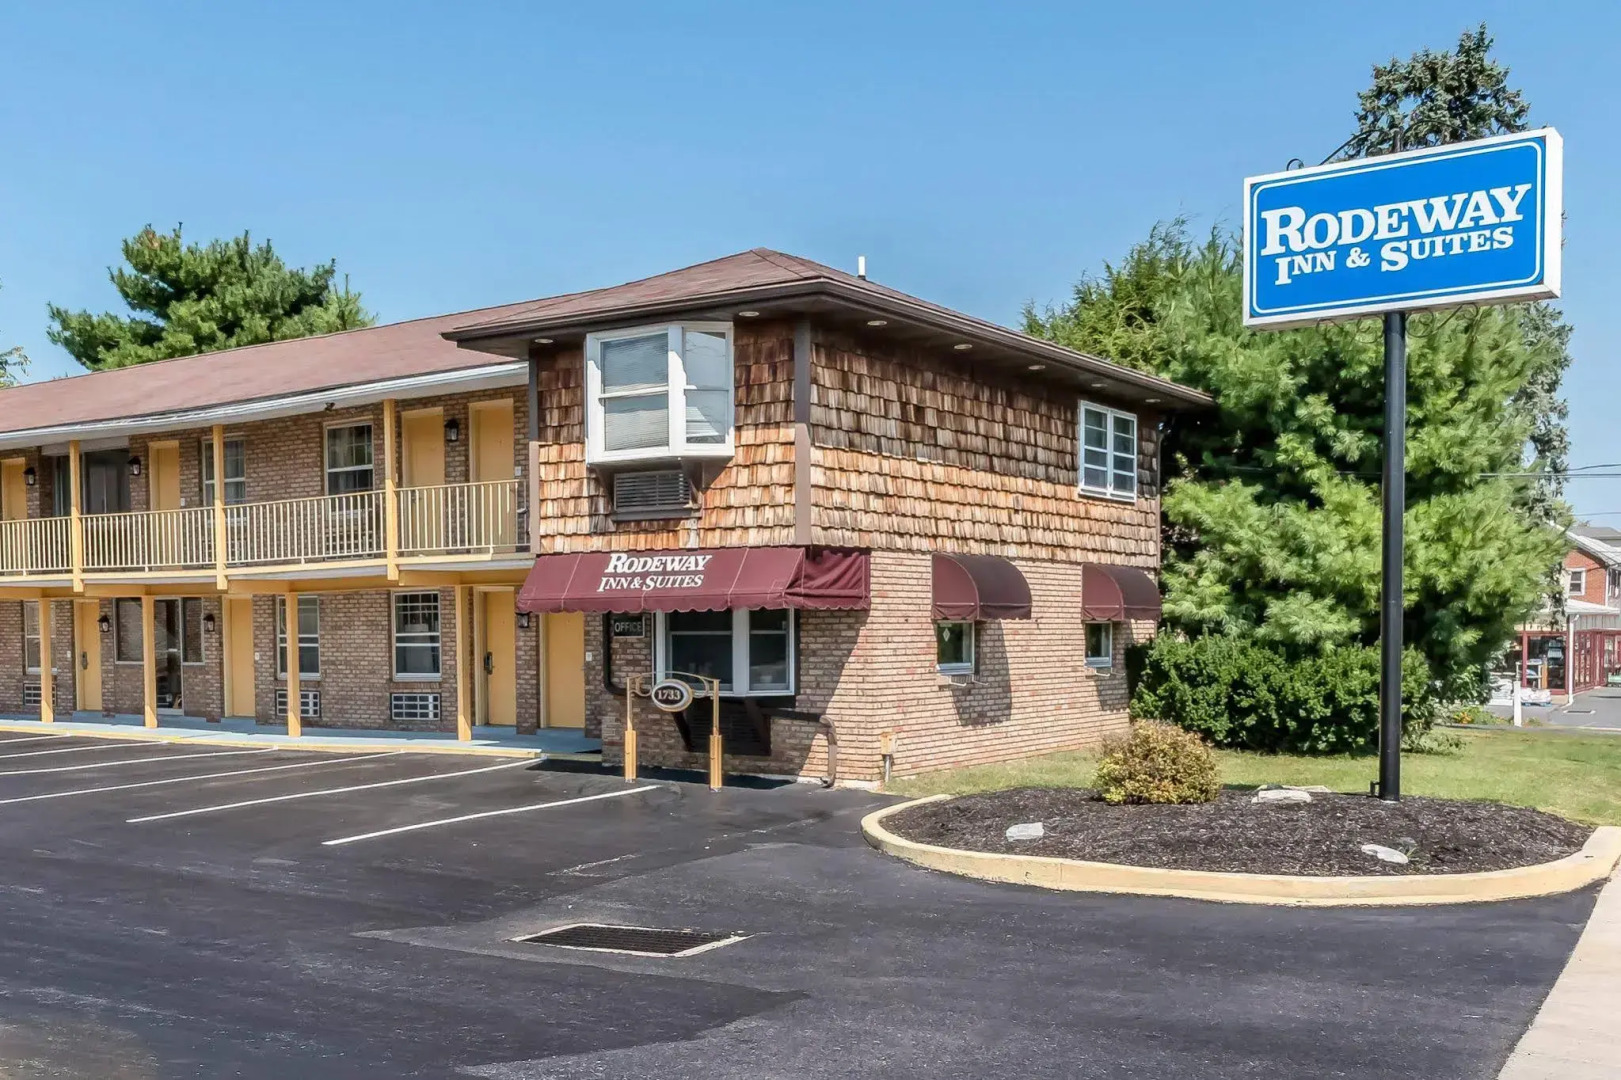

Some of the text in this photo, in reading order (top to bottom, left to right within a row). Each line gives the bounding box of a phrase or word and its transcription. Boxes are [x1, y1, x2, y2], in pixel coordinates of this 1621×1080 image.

[1260, 183, 1532, 256] RODEWAY
[1274, 226, 1514, 286] INN & SUITES
[604, 553, 713, 573] RODEWAY
[597, 574, 704, 592] INN & SUITES
[614, 622, 643, 633] OFFICE
